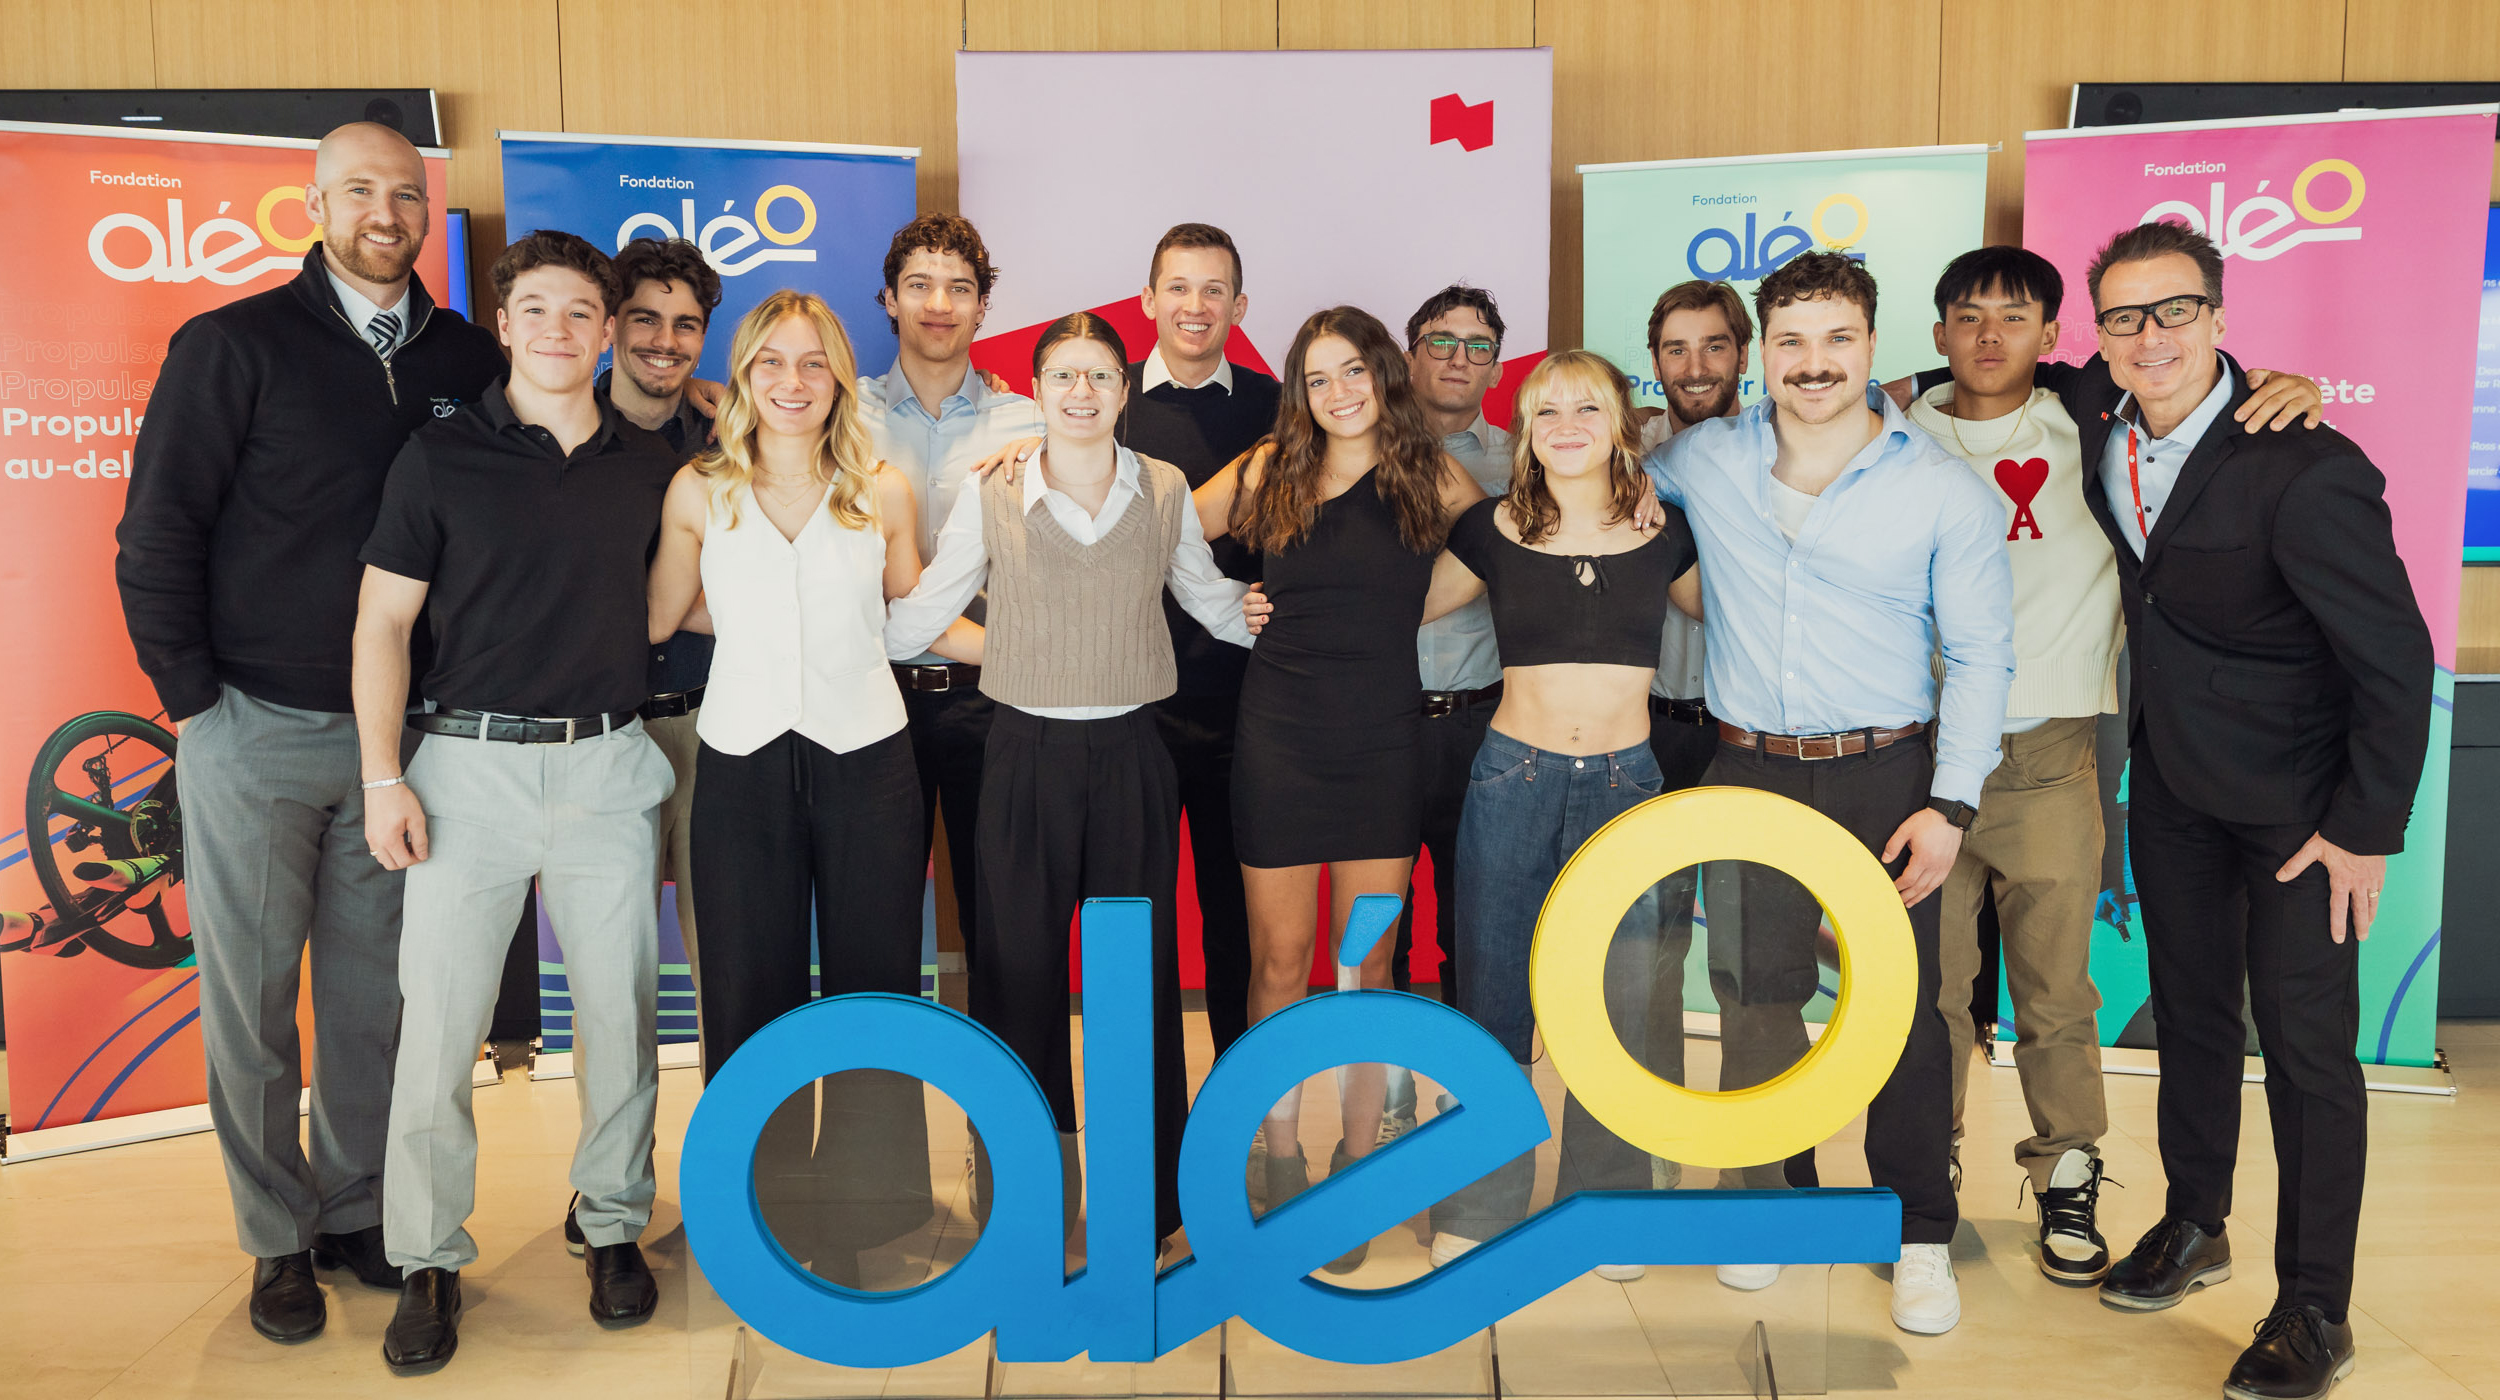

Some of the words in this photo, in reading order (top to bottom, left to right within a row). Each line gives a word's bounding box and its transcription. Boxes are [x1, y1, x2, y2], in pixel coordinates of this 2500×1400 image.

[90, 170, 182, 188] Fondation
[619, 174, 695, 190] Fondation
[2144, 161, 2226, 177] Fondation
[1692, 193, 1757, 206] Fondation
[88, 185, 324, 286] aléo
[0, 332, 169, 370] Propulse
[0, 370, 153, 407] Propuls
[2, 407, 145, 443] Propul
[5, 449, 131, 480] au-del
[680, 786, 1919, 1369] aléo
